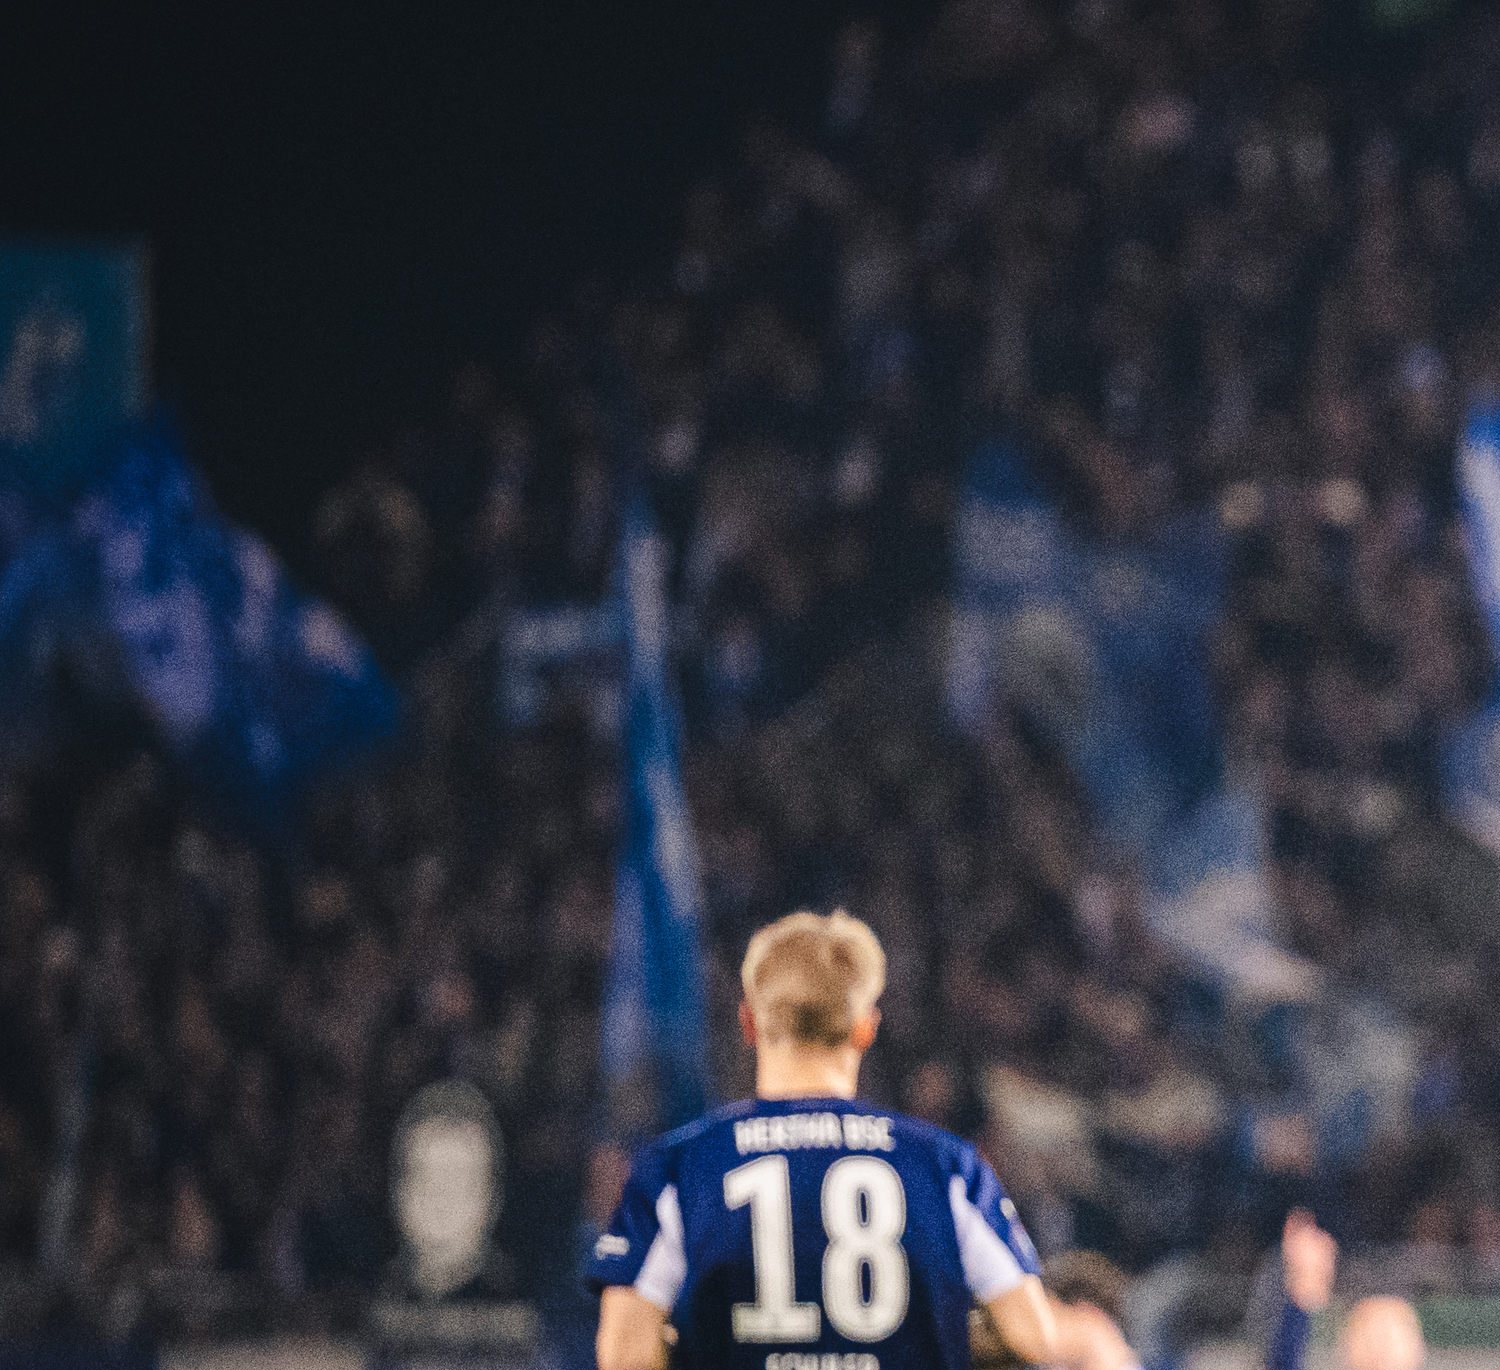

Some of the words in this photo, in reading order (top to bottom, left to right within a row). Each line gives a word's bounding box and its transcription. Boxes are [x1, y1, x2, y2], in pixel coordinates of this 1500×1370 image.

[733, 1113, 843, 1154] HERTHA
[843, 1113, 896, 1152] BSC
[723, 1154, 910, 1346] 18
